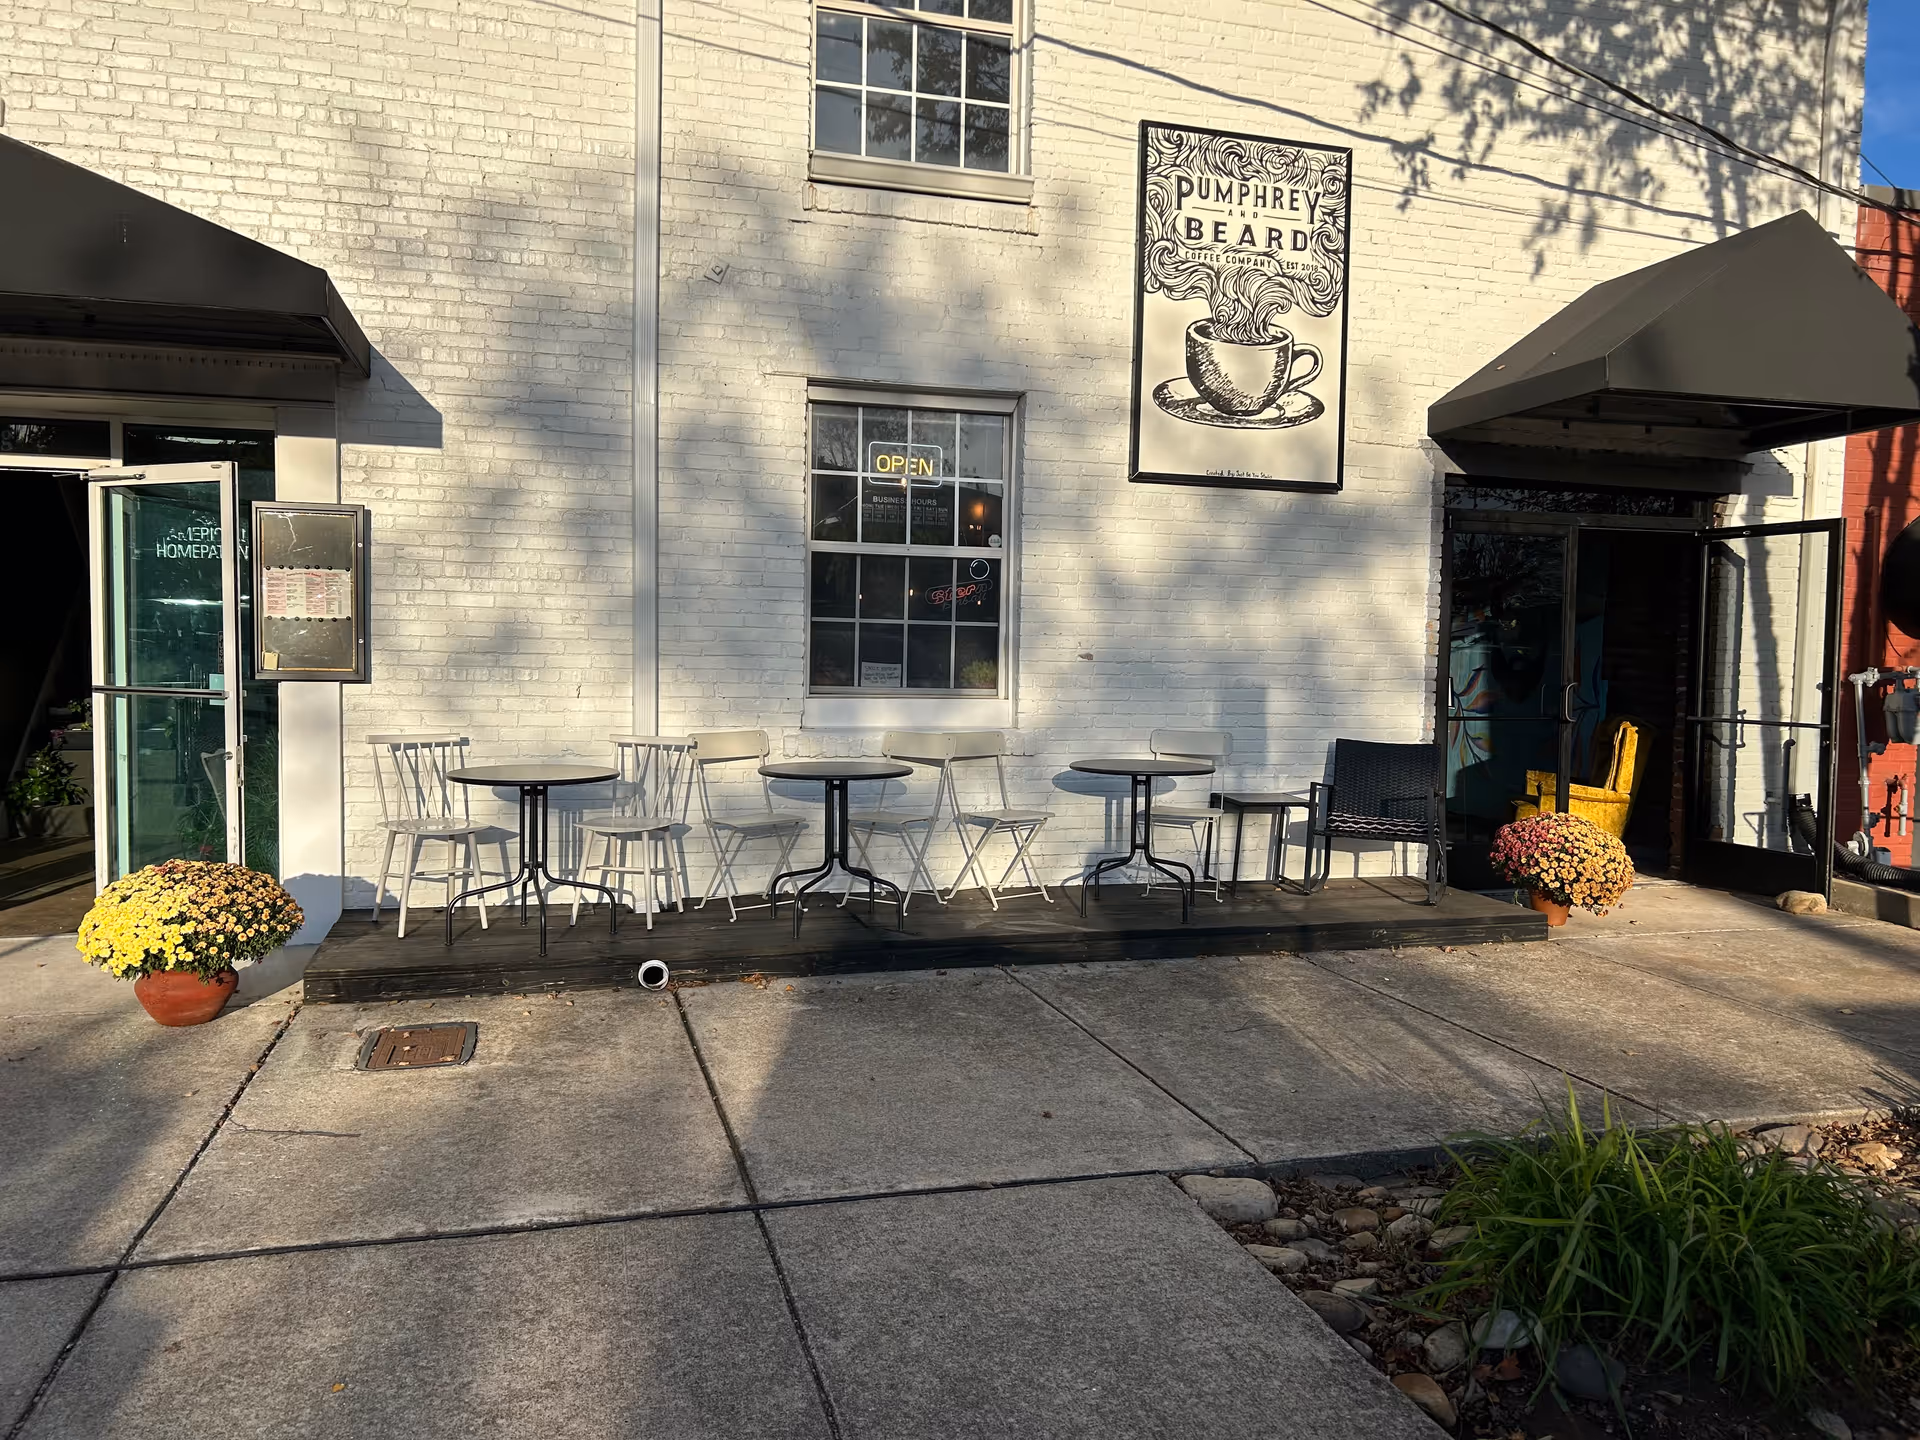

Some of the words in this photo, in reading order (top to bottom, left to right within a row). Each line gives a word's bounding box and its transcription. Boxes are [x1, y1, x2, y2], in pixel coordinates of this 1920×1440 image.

[1174, 174, 1321, 224] PUMPHREY
[1227, 209, 1259, 219] AND
[1184, 216, 1308, 251] BEARD
[1185, 251, 1220, 262] COFFEE
[1226, 255, 1272, 268] COMPANY
[1286, 261, 1299, 270] EST
[876, 454, 934, 476] OPEN
[872, 495, 907, 504] BUSINES
[911, 498, 937, 506] HOURS
